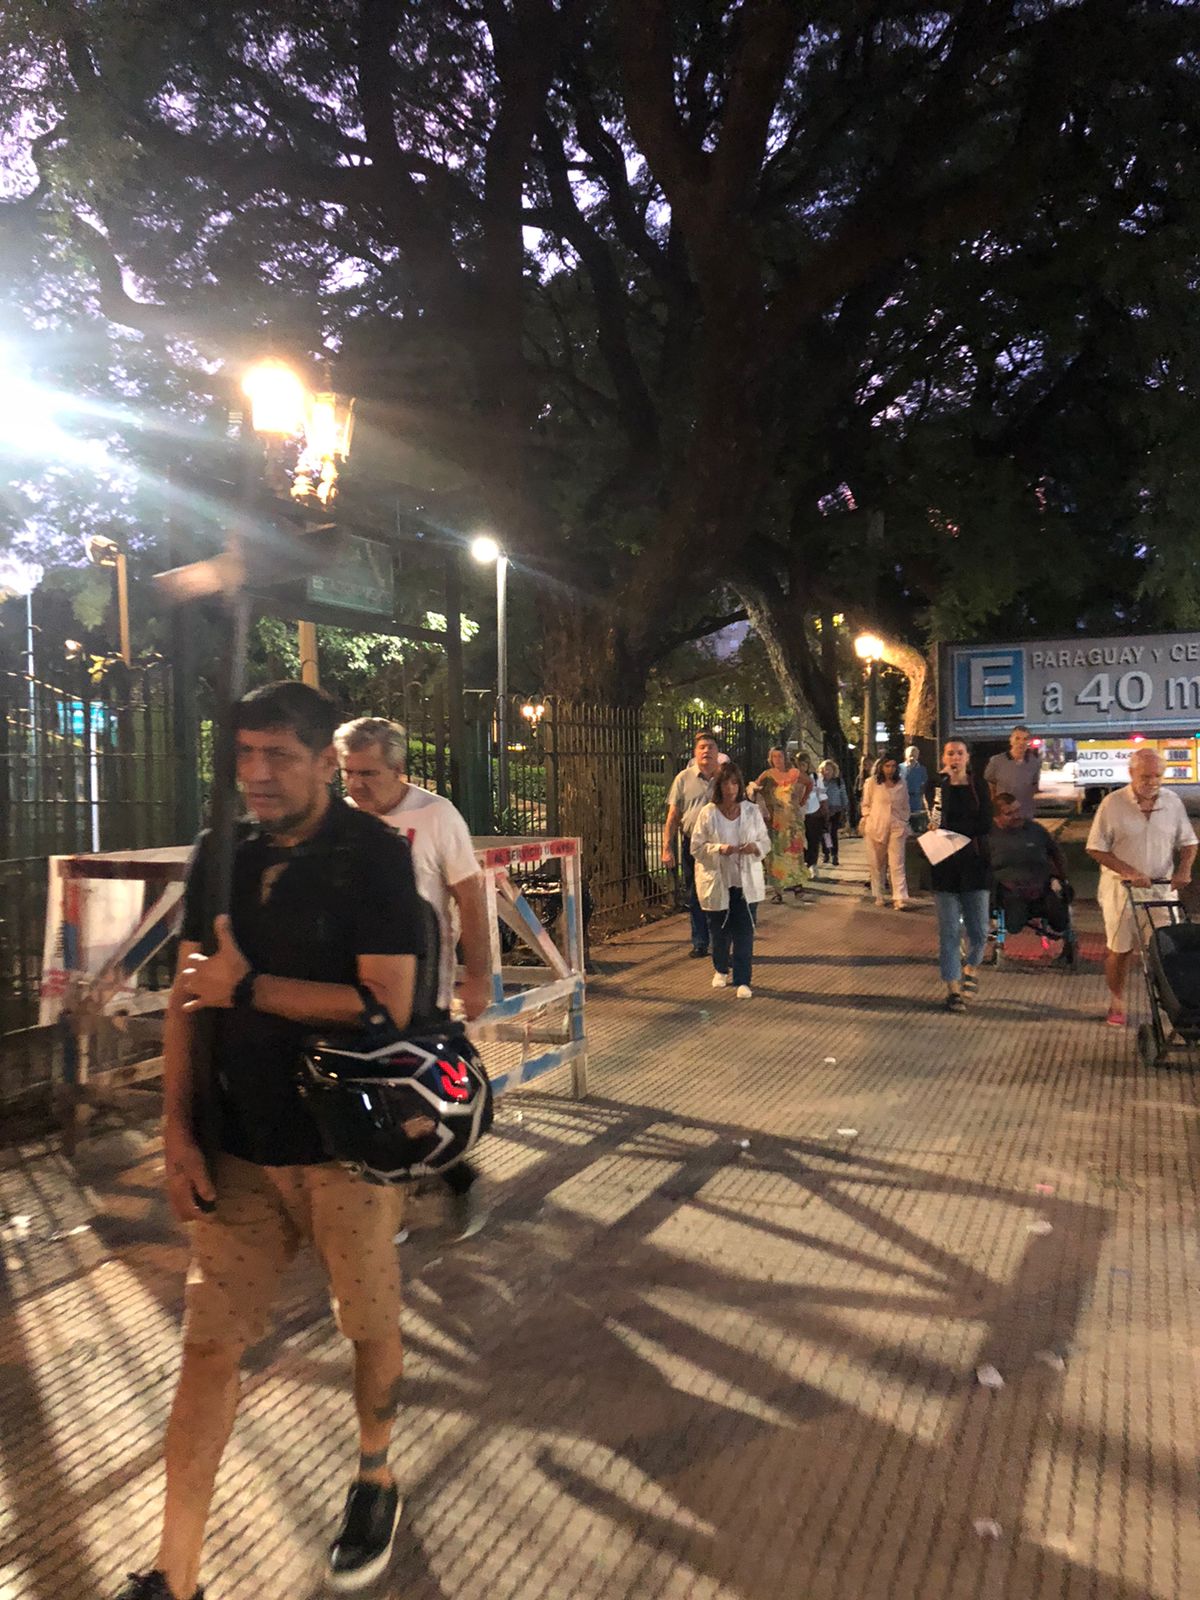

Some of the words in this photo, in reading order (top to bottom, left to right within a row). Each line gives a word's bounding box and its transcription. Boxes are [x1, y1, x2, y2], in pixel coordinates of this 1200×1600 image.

[1032, 646, 1145, 668] PARAGUAY
[970, 656, 1016, 706] E
[1044, 681, 1063, 714] a
[1076, 670, 1153, 712] 40
[1078, 751, 1109, 760] AUTO
[1079, 768, 1114, 777] MOTO
